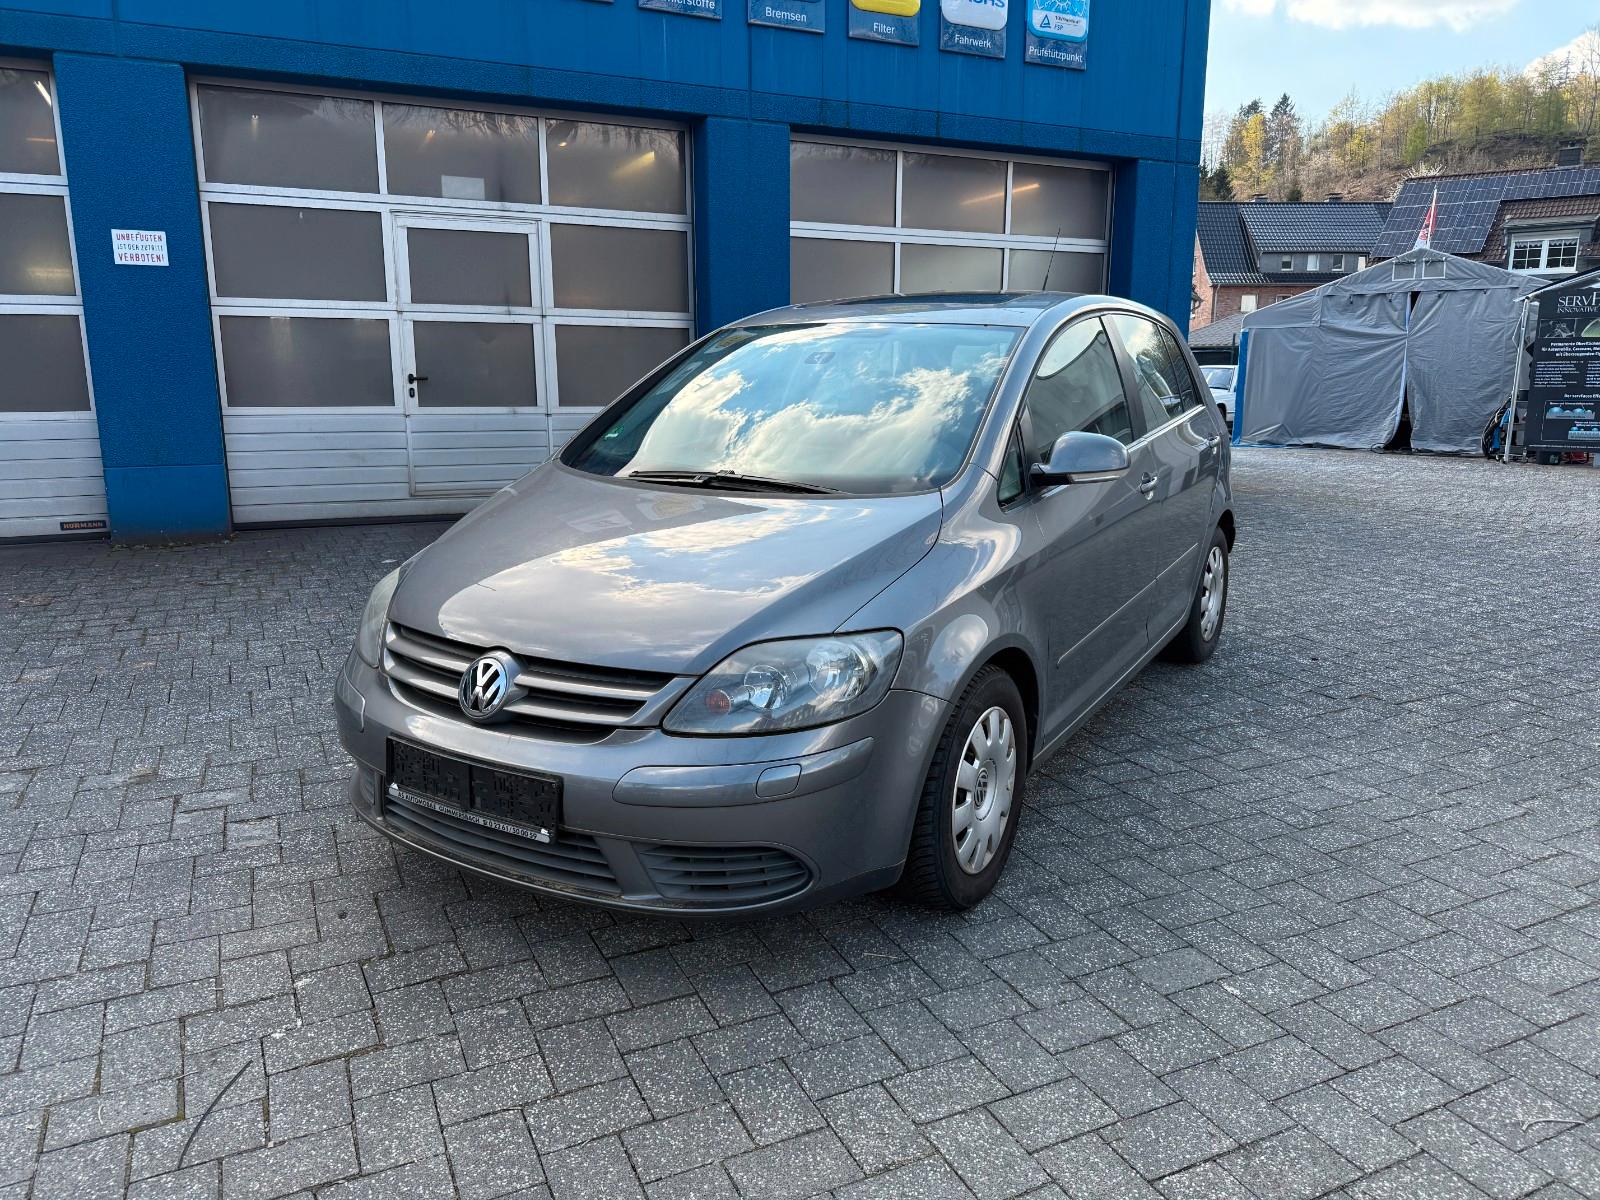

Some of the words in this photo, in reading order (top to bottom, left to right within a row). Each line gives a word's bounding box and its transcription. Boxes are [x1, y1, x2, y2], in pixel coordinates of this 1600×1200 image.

[765, 7, 807, 22] Bremsen
[873, 22, 896, 34] Filter
[954, 34, 992, 49] Fahrwerk
[1029, 46, 1083, 63] Prüfstützpunkt
[116, 233, 163, 242] UNBEFUGTEN
[118, 252, 165, 263] VERBOTEN!
[1557, 291, 1600, 307] SERVF
